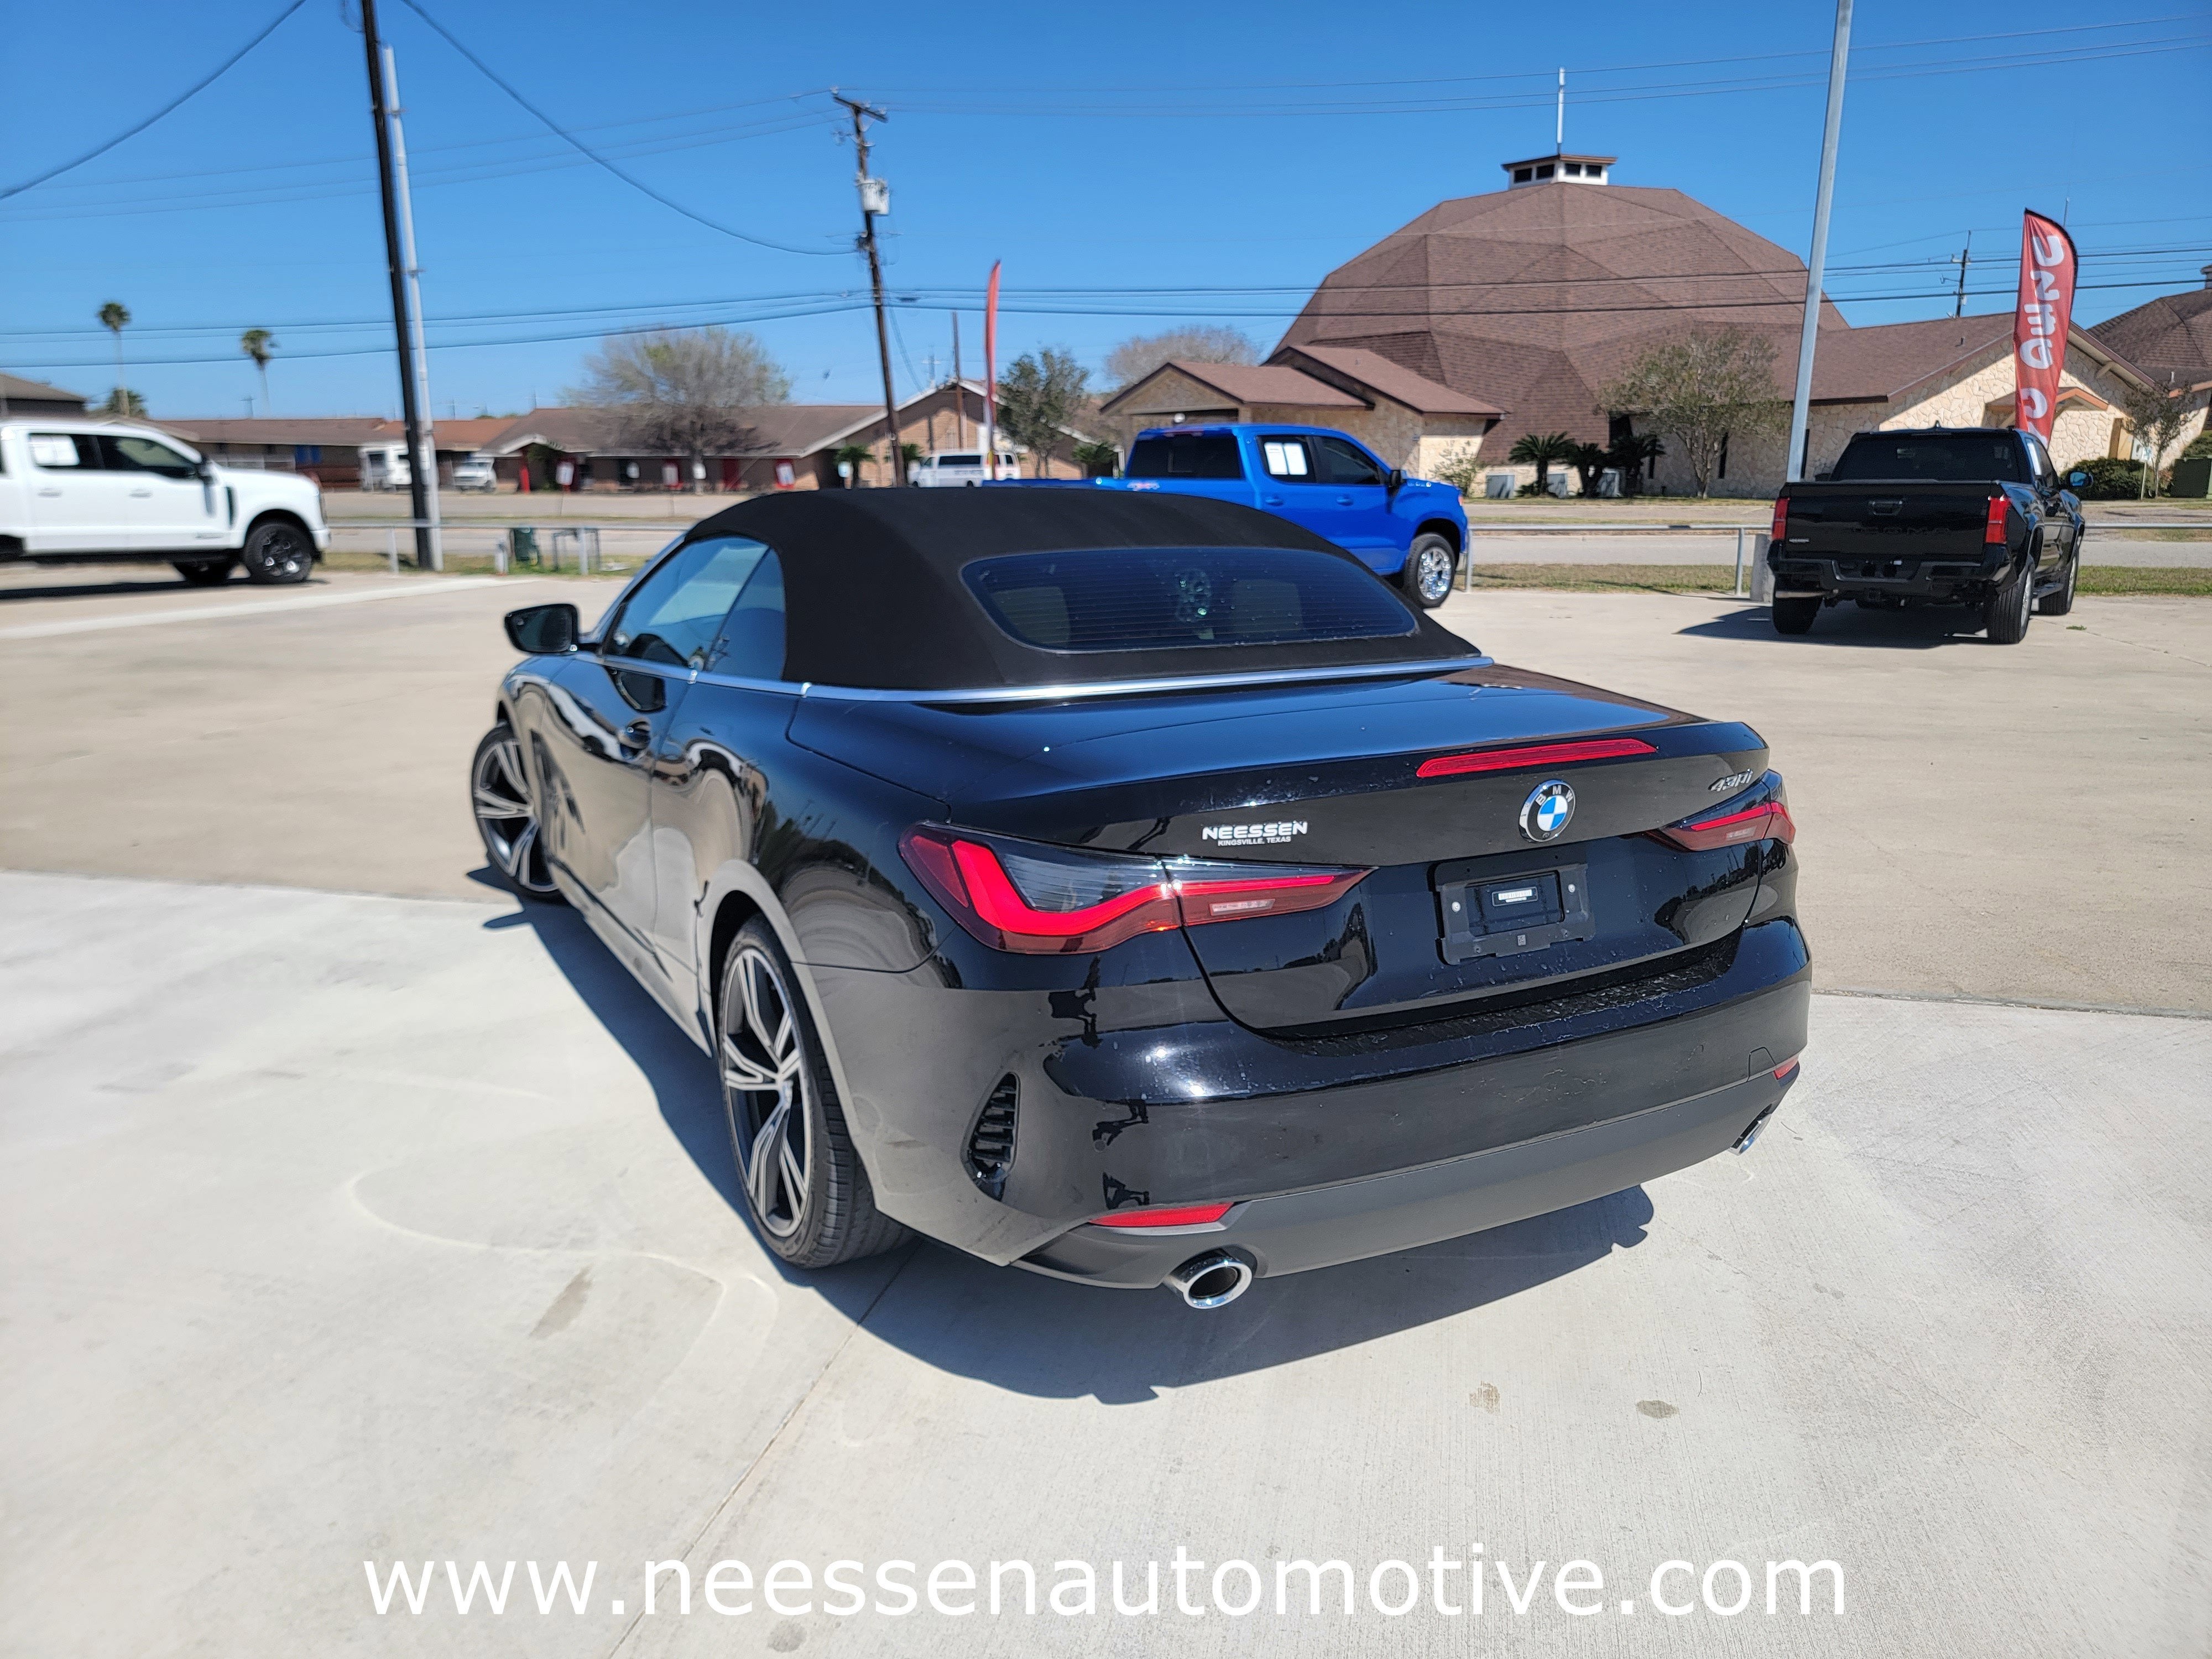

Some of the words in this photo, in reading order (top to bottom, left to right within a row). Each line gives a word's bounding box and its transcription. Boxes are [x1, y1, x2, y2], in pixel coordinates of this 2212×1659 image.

[1535, 784, 1573, 806] BMW
[1202, 821, 1308, 840] NEESSEN
[1217, 837, 1265, 847] KINGSVILLE,
[1266, 836, 1291, 844] TEXAS
